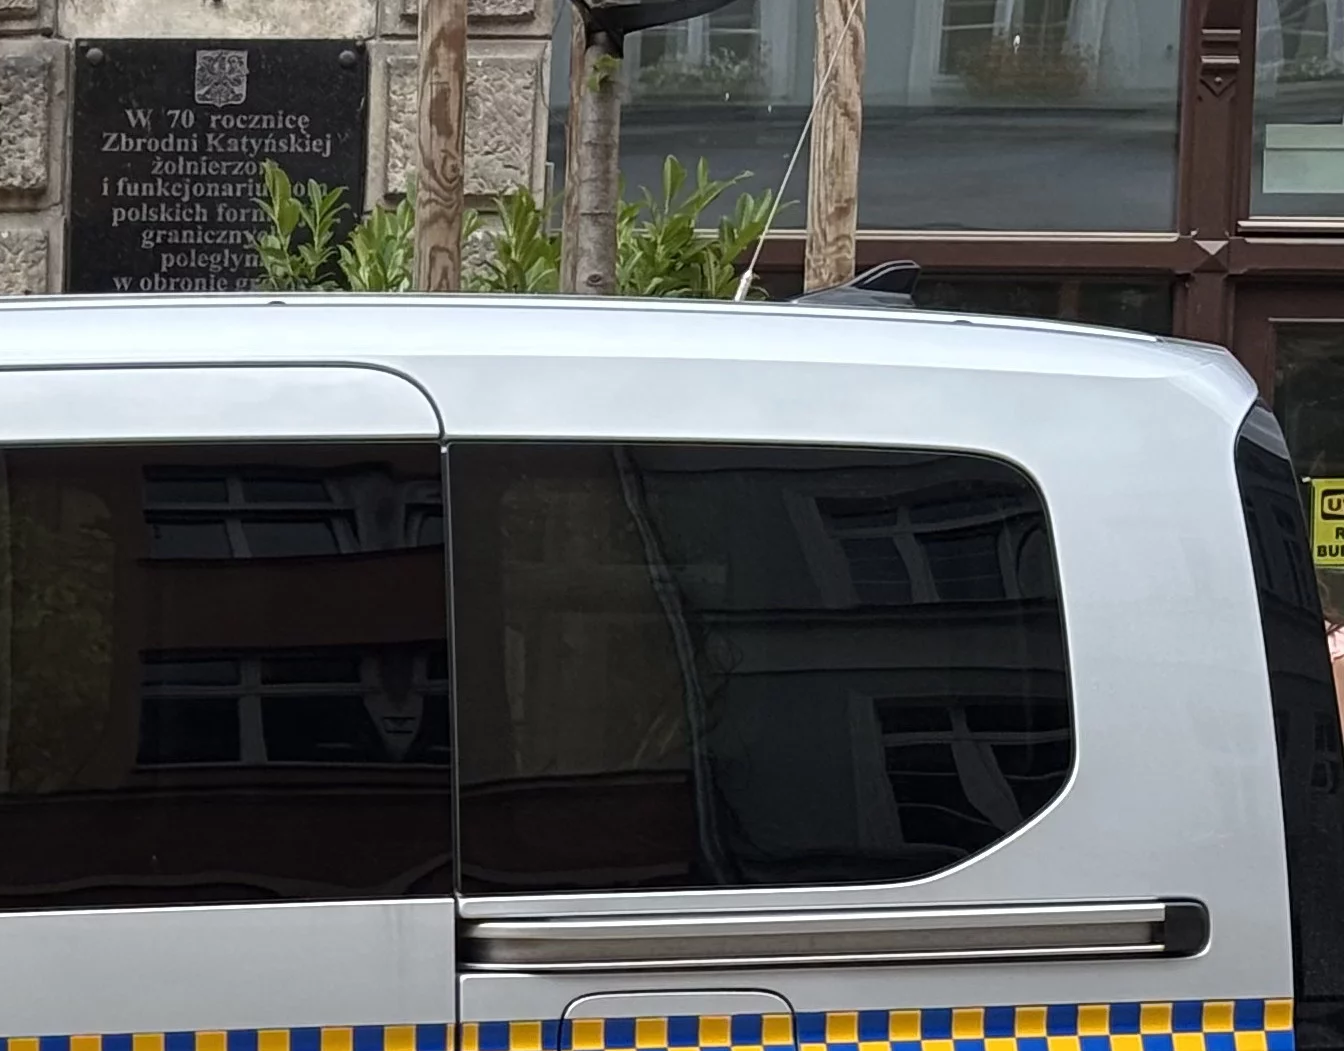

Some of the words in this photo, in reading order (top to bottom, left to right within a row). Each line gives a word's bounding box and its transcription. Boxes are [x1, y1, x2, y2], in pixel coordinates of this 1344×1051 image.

[125, 109, 153, 128] W
[166, 109, 195, 129] 70
[210, 110, 311, 134] rocznicę
[102, 132, 198, 152] Zbrodni
[206, 131, 332, 157] Katyńskiej
[101, 176, 109, 197] i
[112, 203, 208, 226] polskich
[113, 277, 132, 291] w
[139, 272, 228, 292] obronie
[1327, 497, 1344, 512] U
